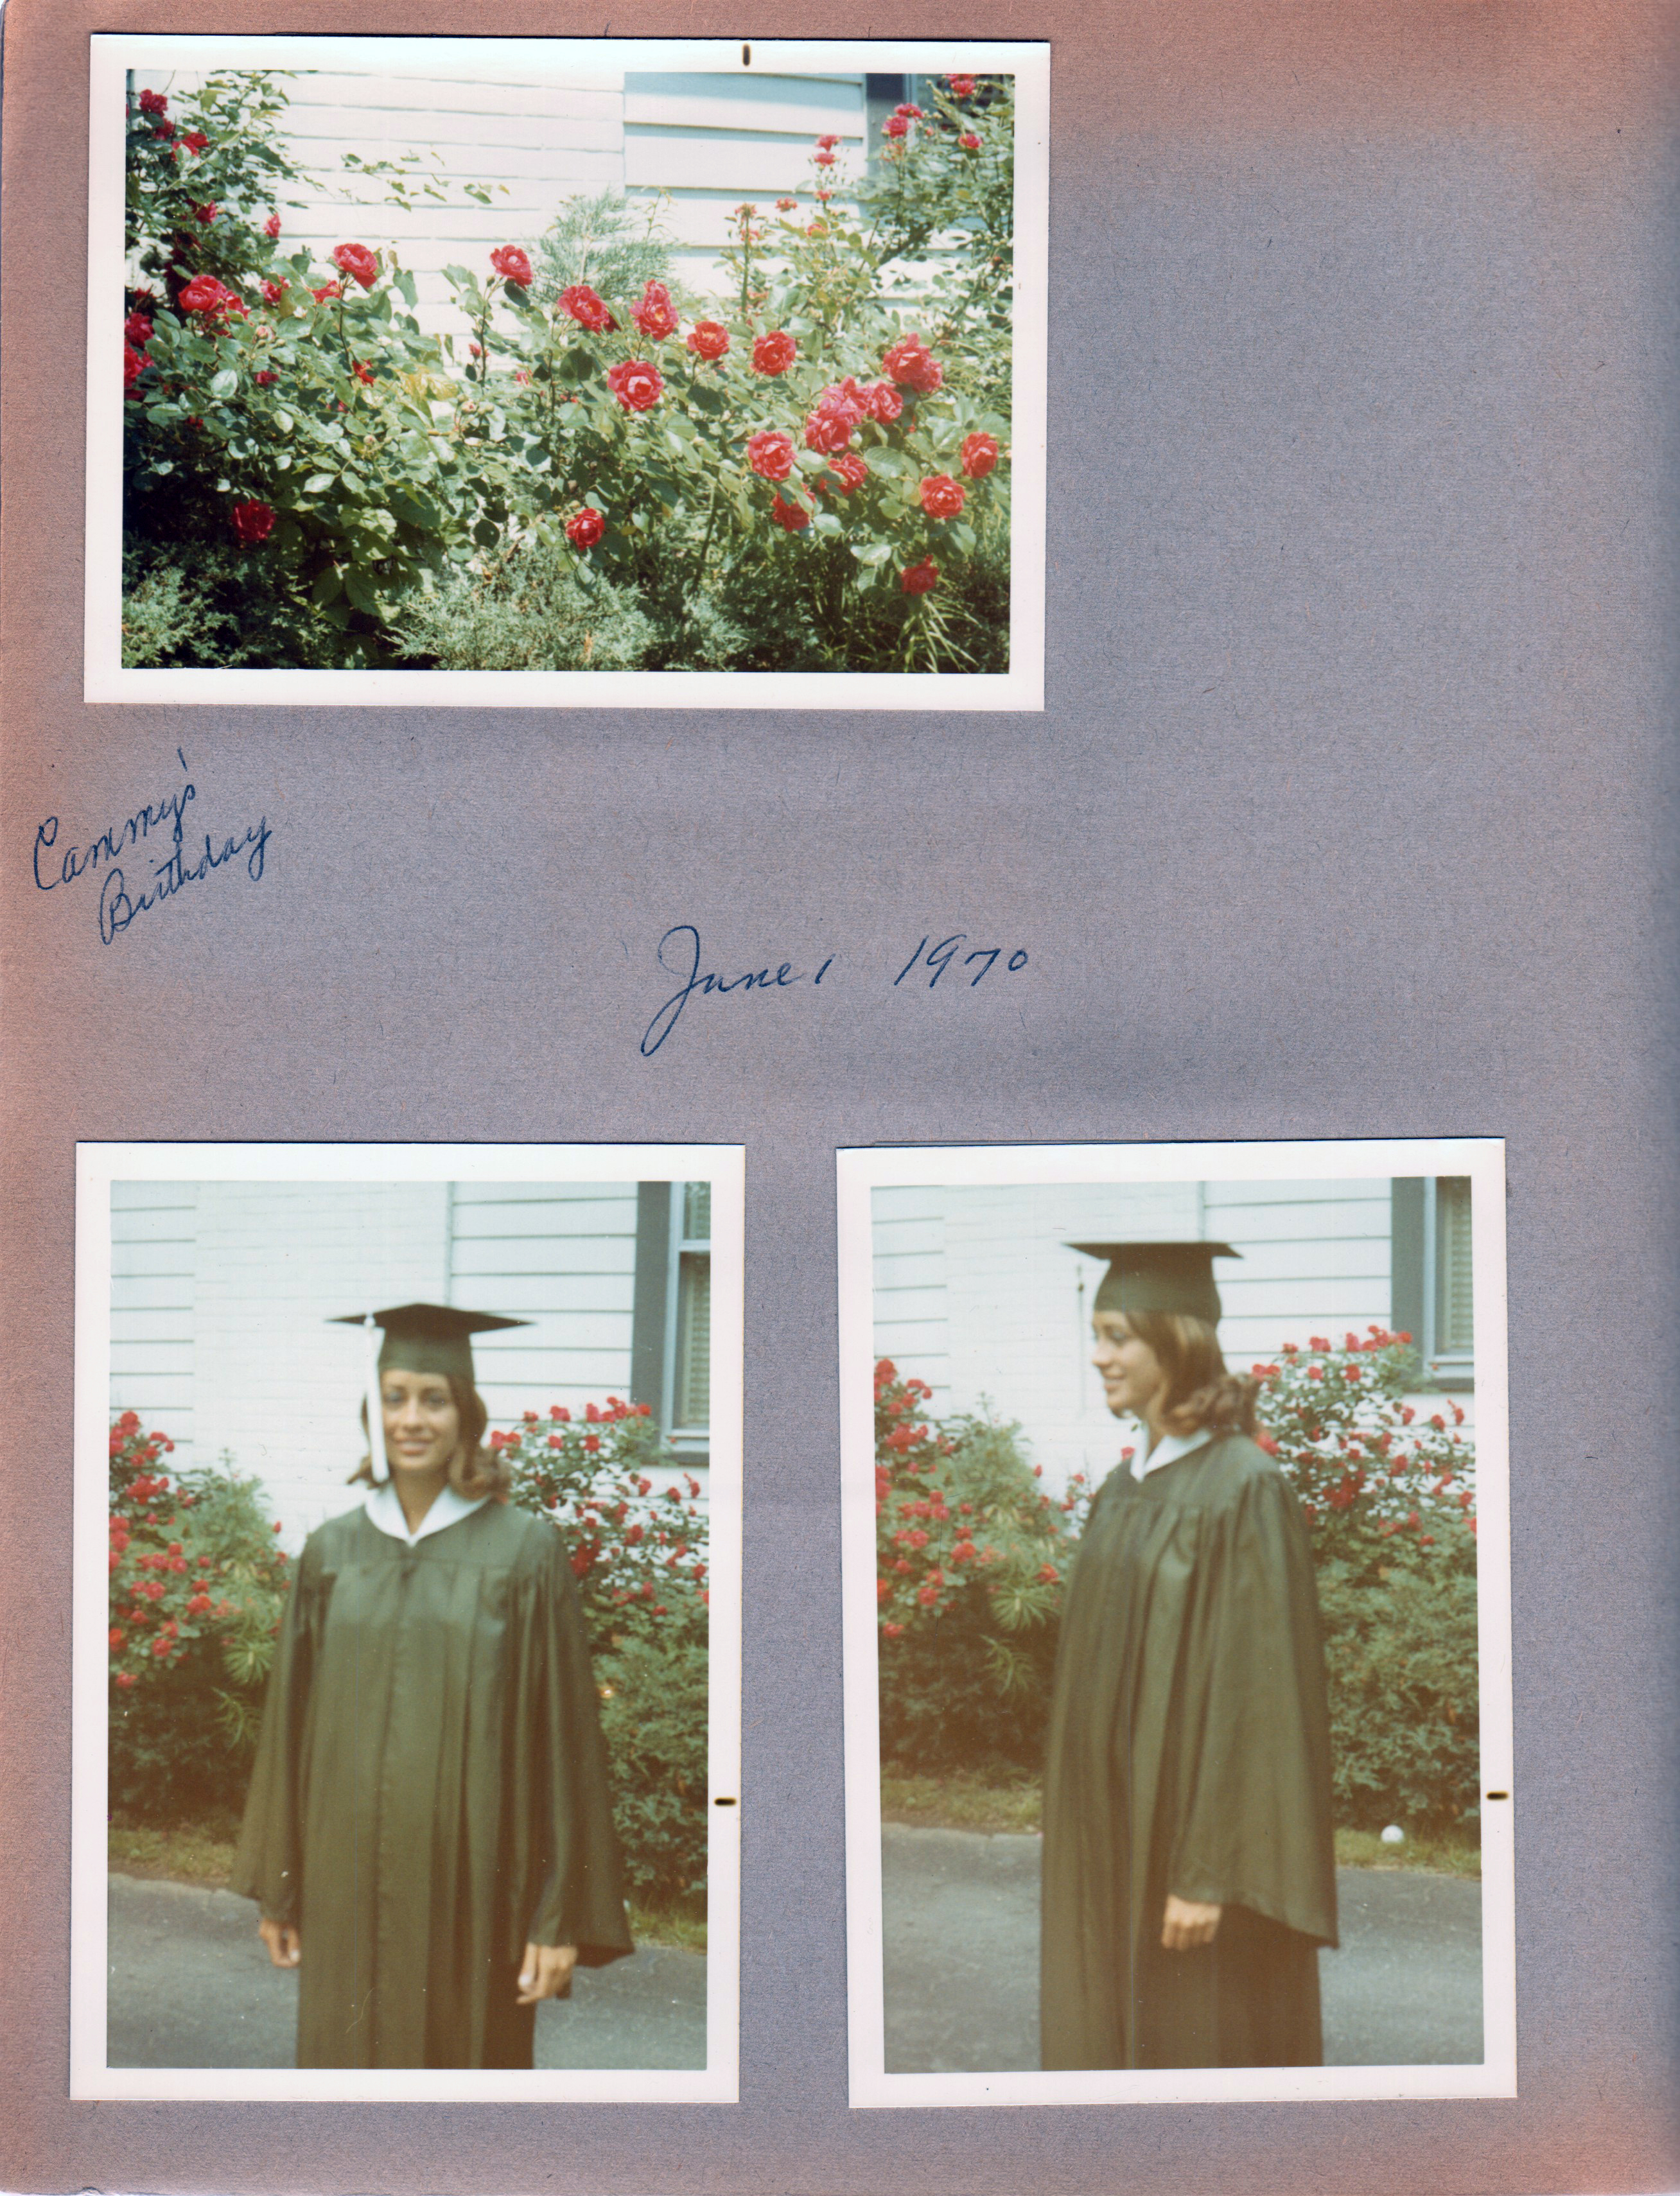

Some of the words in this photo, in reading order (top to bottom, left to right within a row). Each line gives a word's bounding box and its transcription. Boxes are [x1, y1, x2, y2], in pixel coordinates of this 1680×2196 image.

[99, 815, 273, 946] Birthday
[640, 925, 802, 1058] June
[894, 933, 1030, 989] 1970
